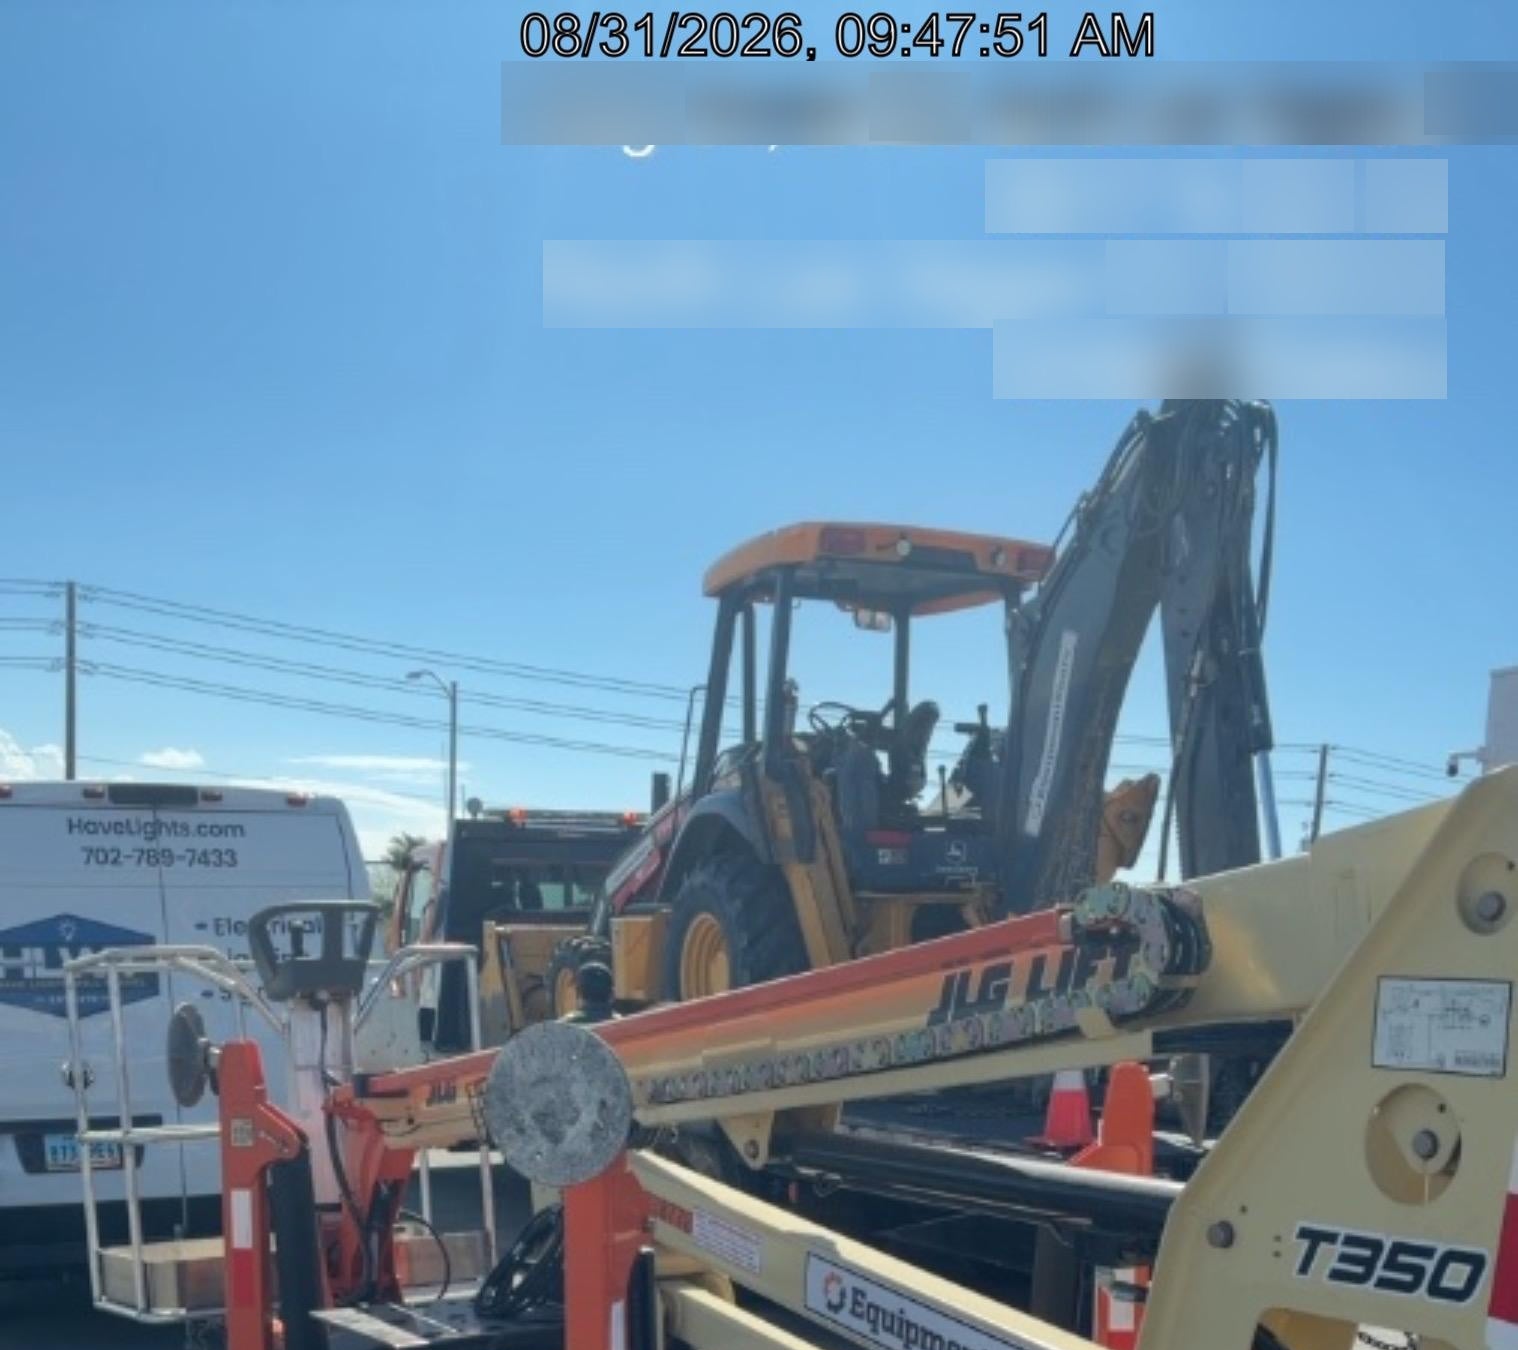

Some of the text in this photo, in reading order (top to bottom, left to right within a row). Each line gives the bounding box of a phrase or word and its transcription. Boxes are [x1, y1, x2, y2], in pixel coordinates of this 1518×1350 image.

[67, 817, 245, 841] HaveLights.com
[82, 846, 238, 868] 702-789-7433
[928, 965, 1013, 1027] JLG
[1296, 1225, 1486, 1303] T350
